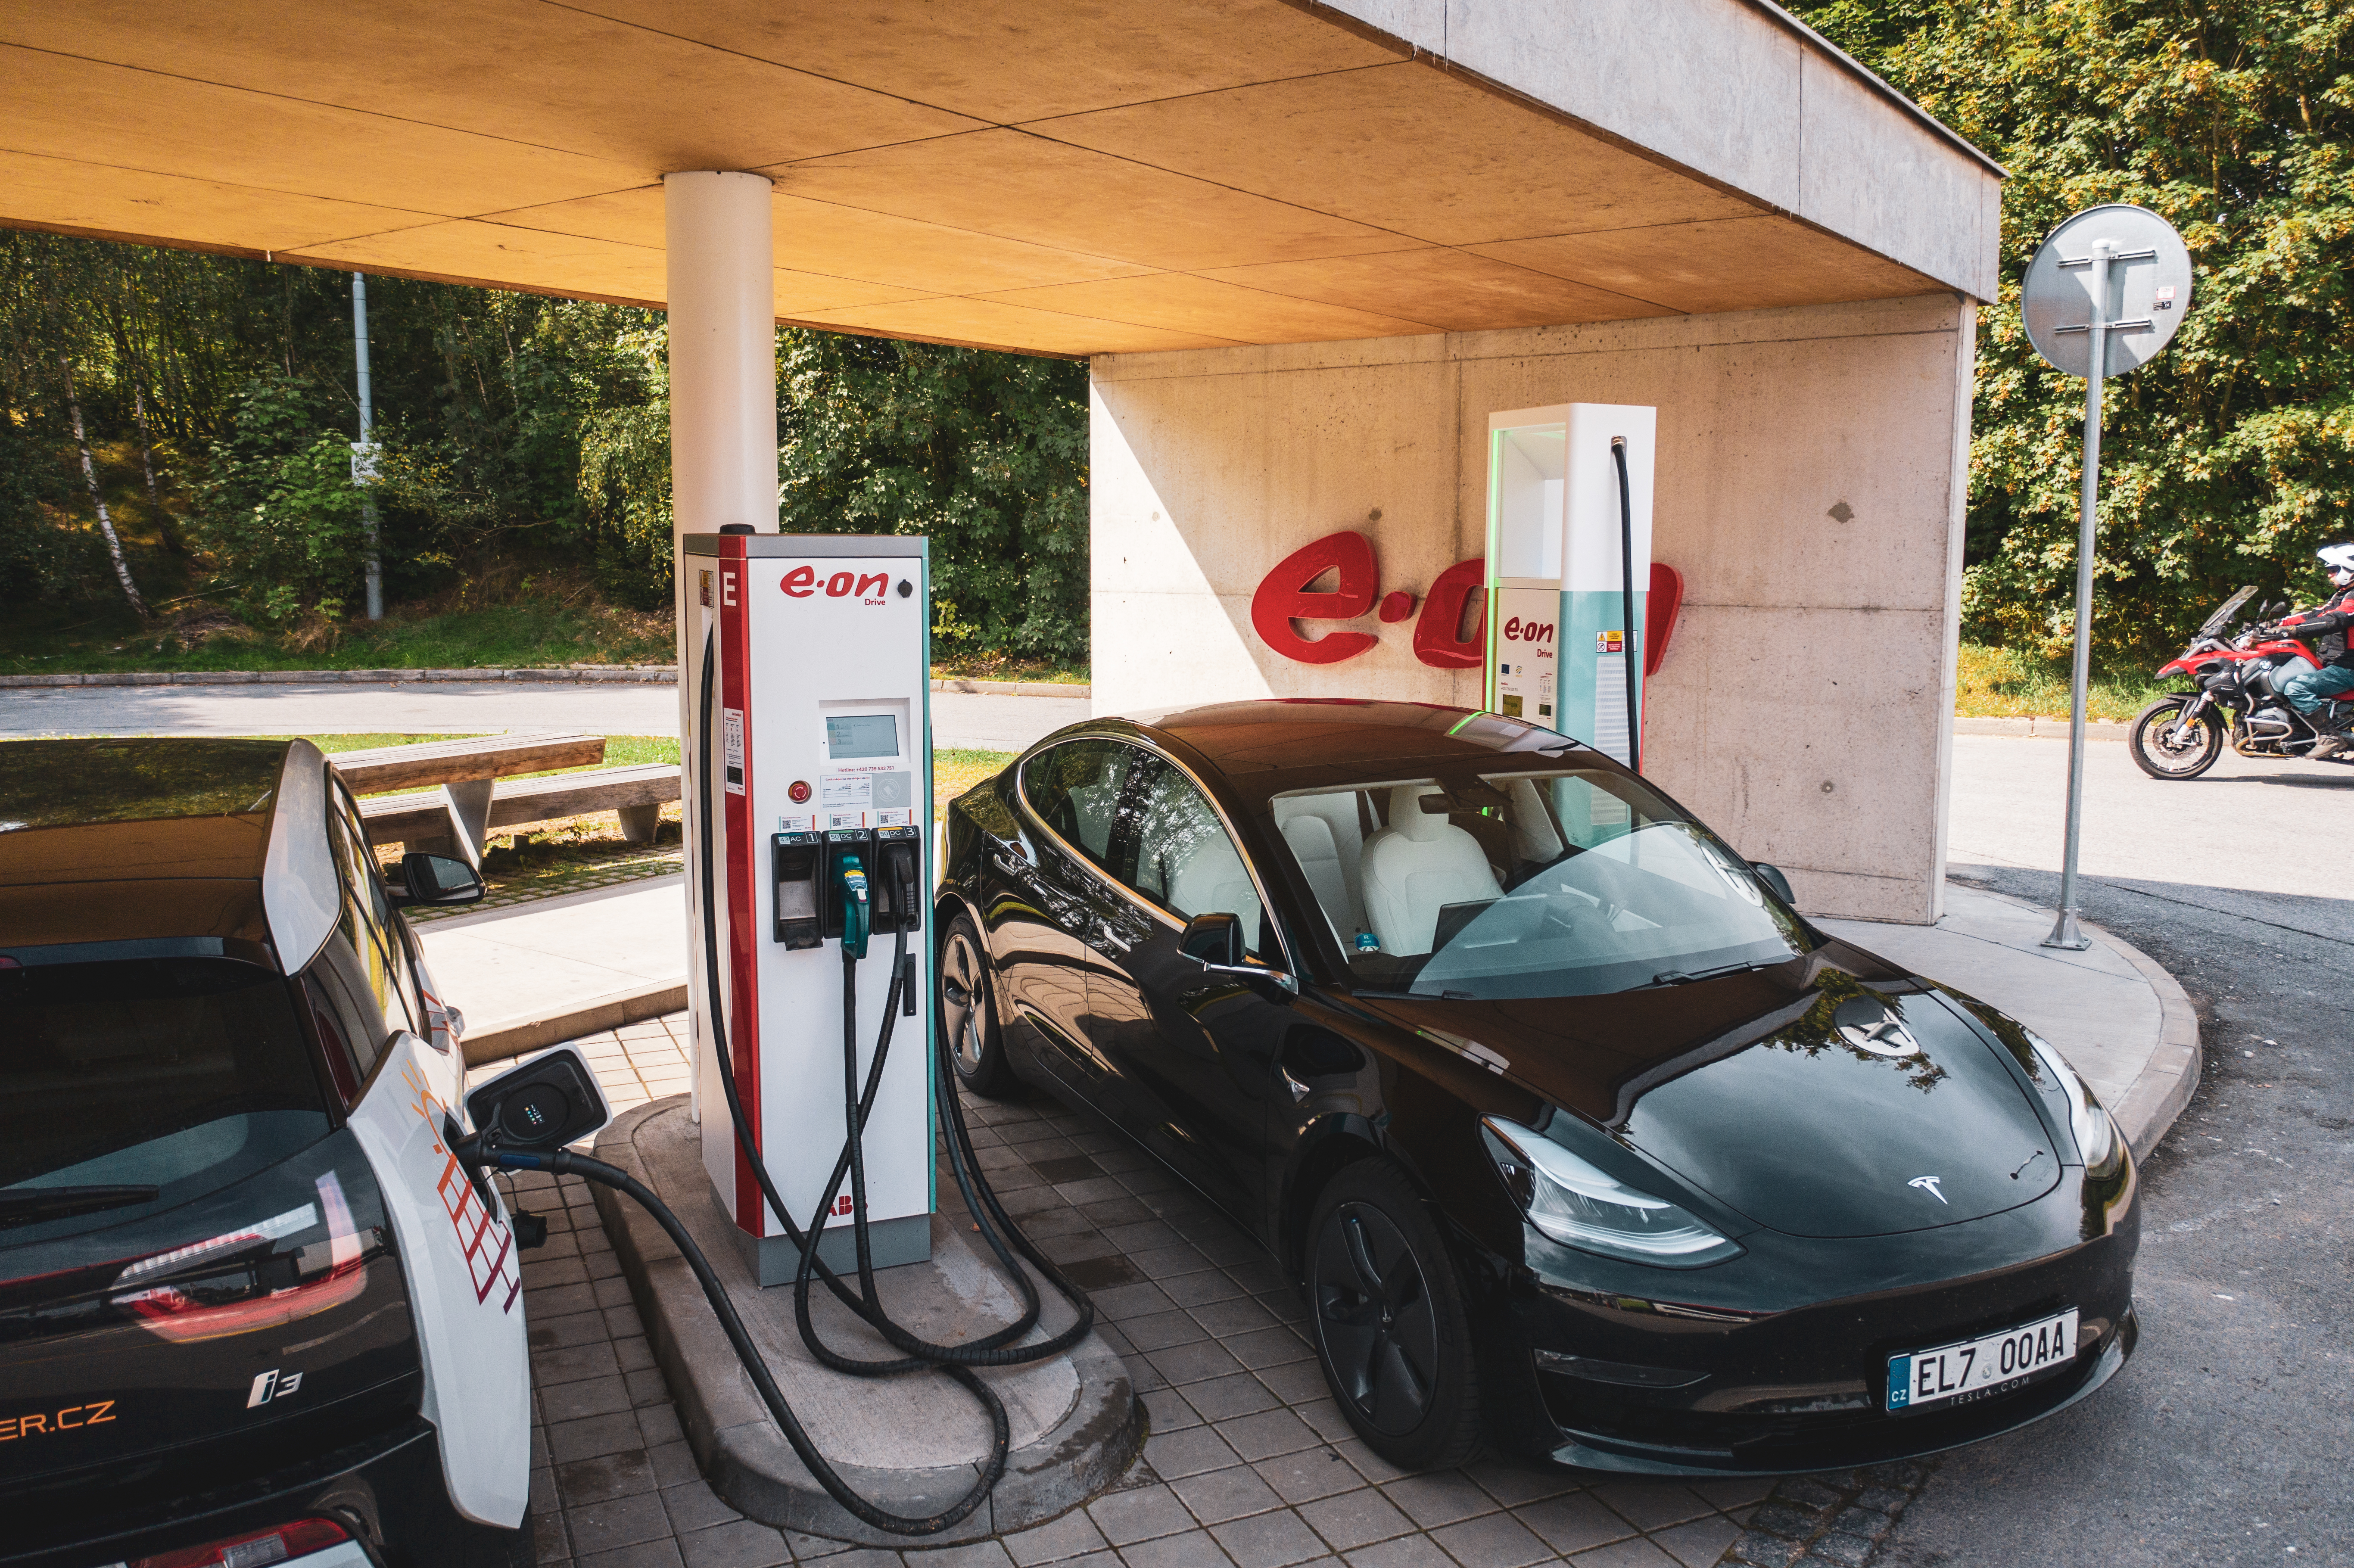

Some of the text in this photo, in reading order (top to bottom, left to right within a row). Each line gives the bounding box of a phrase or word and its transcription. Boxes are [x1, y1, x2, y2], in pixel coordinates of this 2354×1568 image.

[723, 572, 736, 606] E
[1537, 649, 1553, 659] Drive
[808, 833, 814, 842] 1
[857, 831, 866, 839] 2
[906, 827, 915, 836] 3
[1917, 1347, 1976, 1398] EL7
[247, 1369, 303, 1409] i3
[1891, 1389, 1907, 1402] CZ
[1950, 1377, 2030, 1406] TESLA.COM
